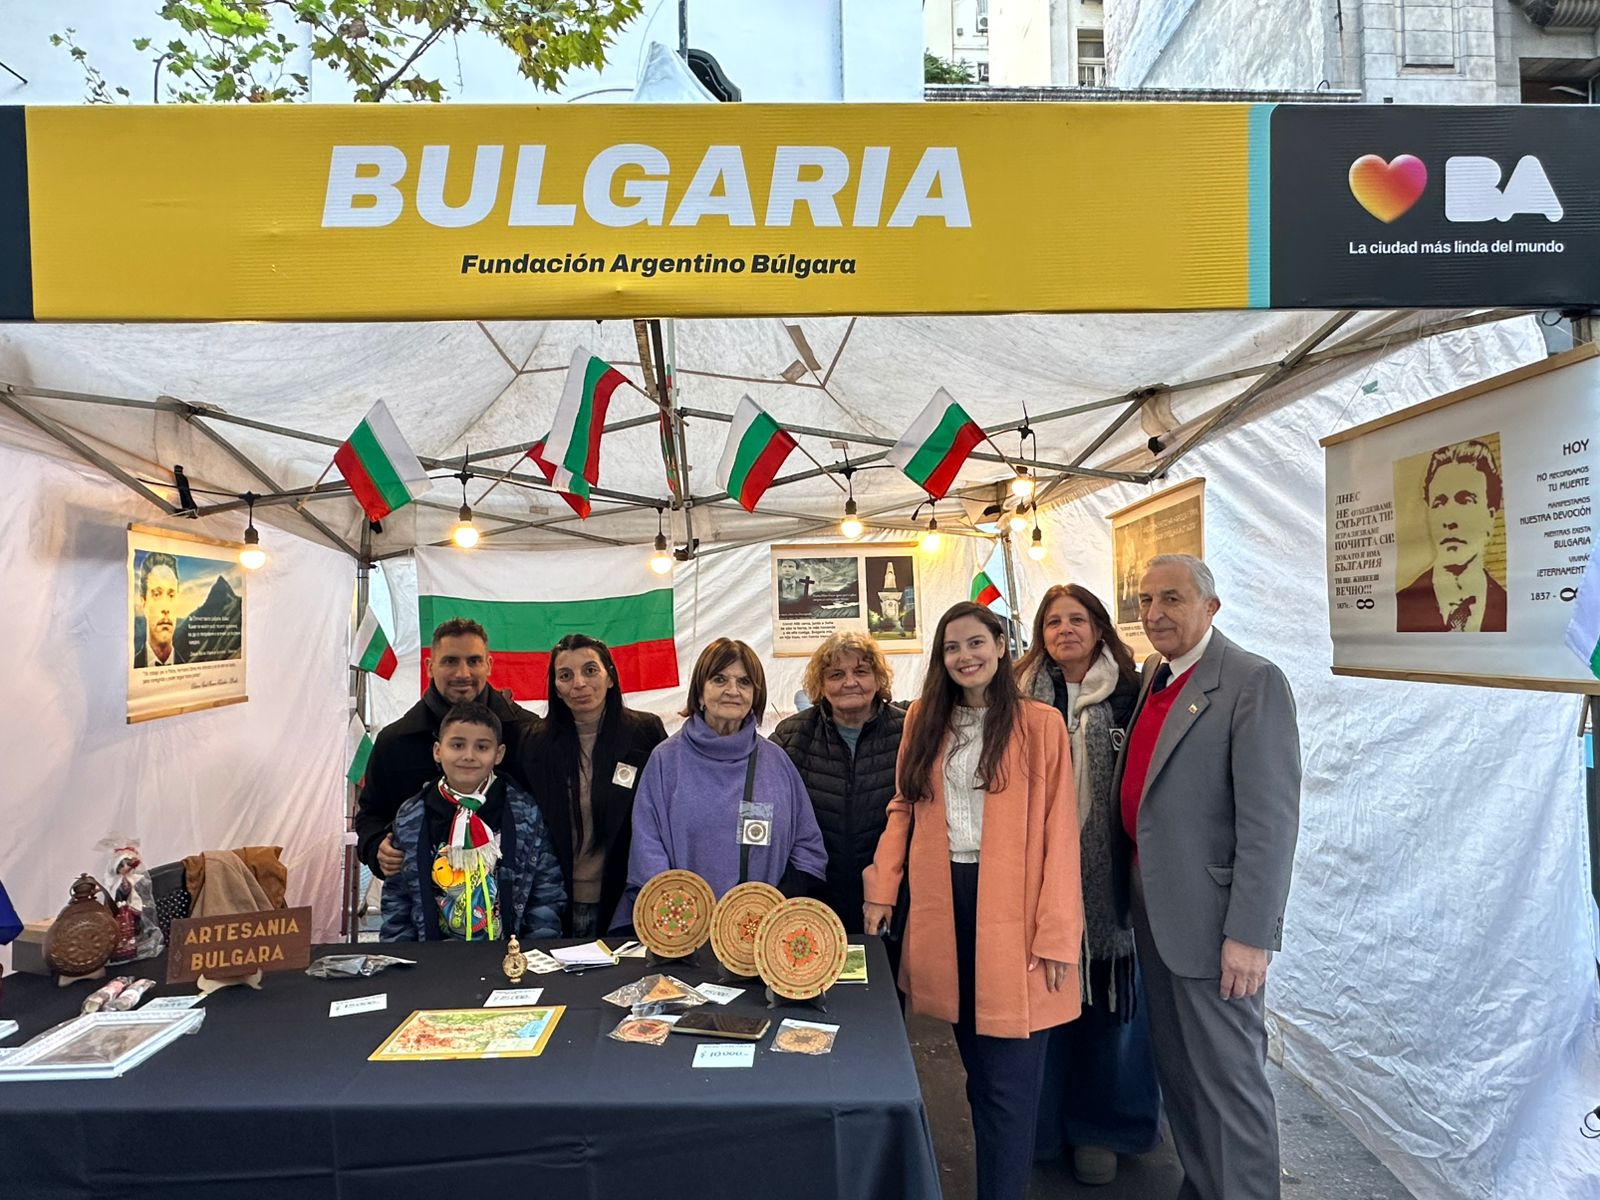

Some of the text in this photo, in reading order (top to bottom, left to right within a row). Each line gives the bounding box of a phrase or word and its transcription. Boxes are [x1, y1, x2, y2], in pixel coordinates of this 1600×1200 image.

[321, 144, 972, 228] BULGARIA
[1445, 154, 1564, 222] BA
[1349, 240, 1565, 254] La ciudad más linda del mundo
[461, 253, 857, 278] Fundación Argentino Búlgara
[1563, 438, 1590, 456] HOY
[1536, 472, 1548, 482] NO
[1548, 476, 1590, 492] TU MUERTE
[1335, 491, 1361, 506] ДНЕС
[1336, 508, 1350, 520] НЕ
[1520, 505, 1592, 525] NUESTRA DEVOCIÓN
[1335, 515, 1378, 530] СМЪРТТА
[1334, 532, 1395, 551] ПОЧИТТА СИ!
[1554, 536, 1592, 549] BULGARIA
[1334, 558, 1382, 572] БЪЛГАРИЯ
[1536, 565, 1587, 578] ¡ETERNAMENT
[1335, 584, 1373, 597] ВЕЧНО!!!
[1530, 591, 1551, 601] 1837
[183, 917, 300, 946] ARTESANIA
[190, 943, 285, 972] BULGARA
